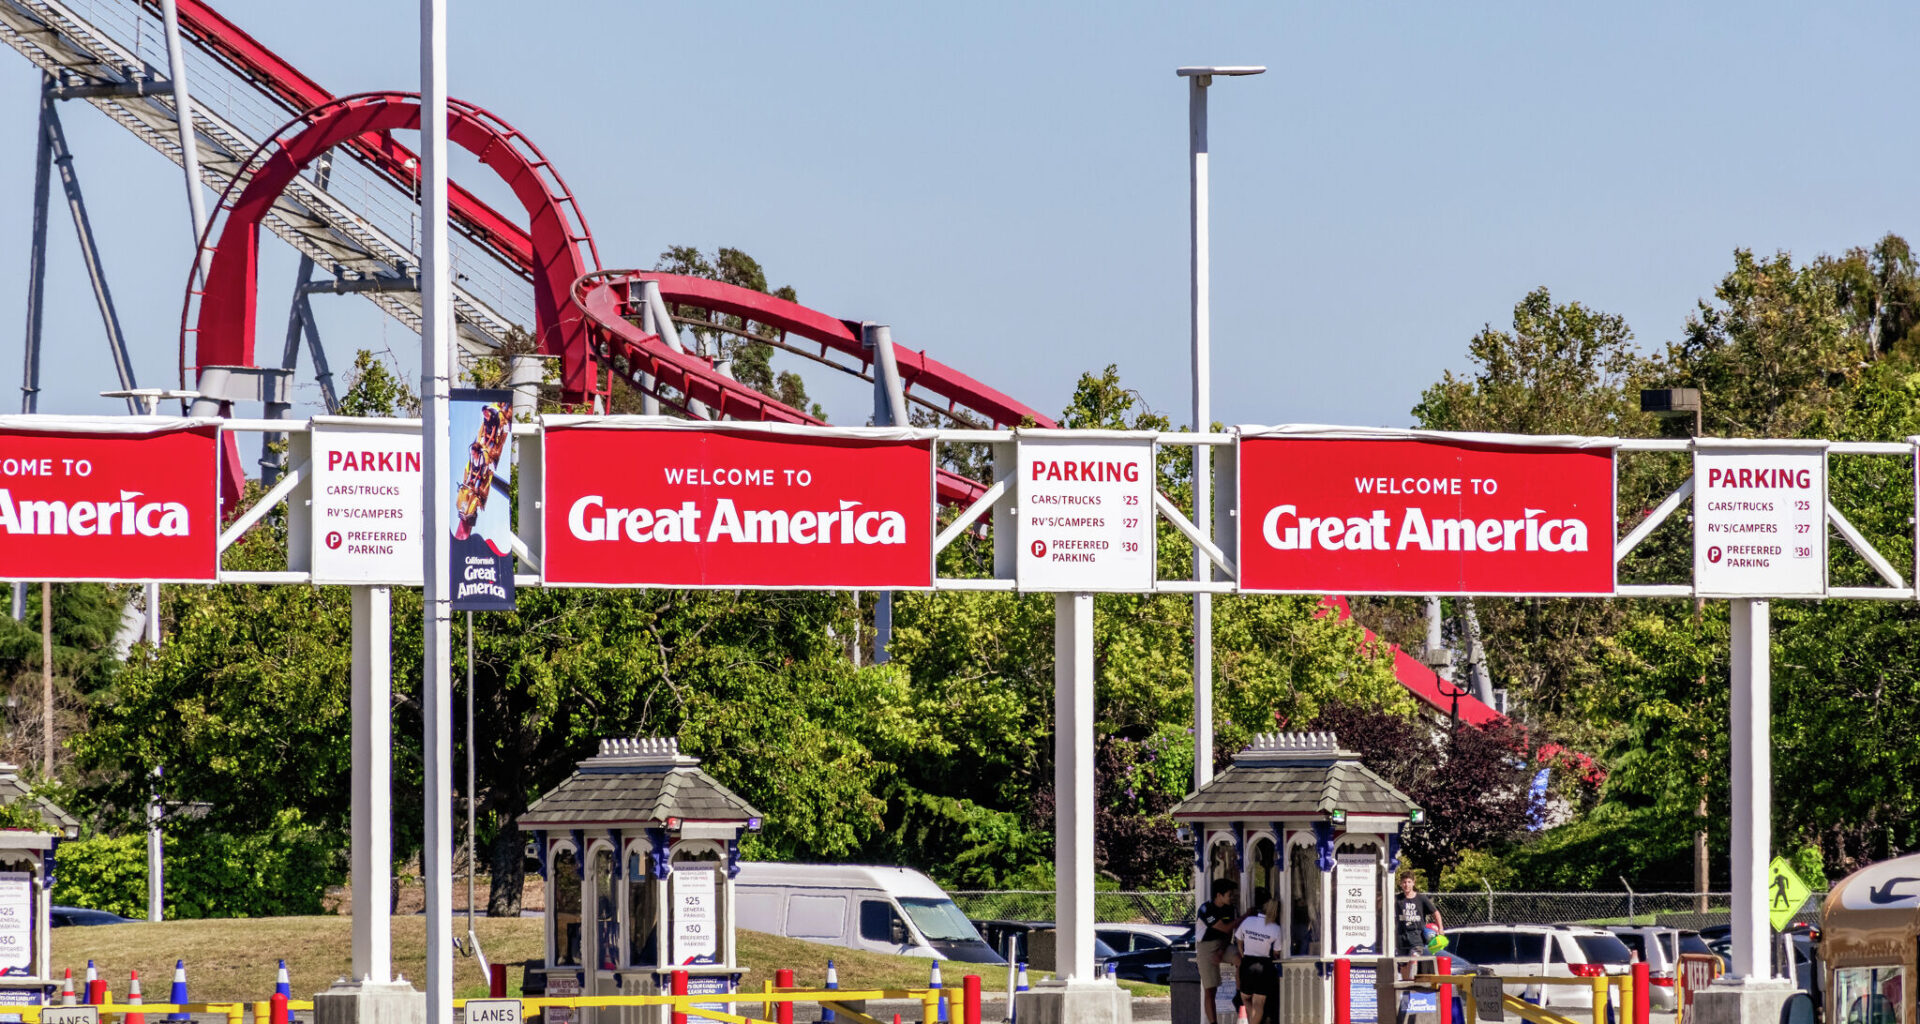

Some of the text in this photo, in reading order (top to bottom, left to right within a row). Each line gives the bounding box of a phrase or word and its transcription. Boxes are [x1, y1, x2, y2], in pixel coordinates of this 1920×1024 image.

[328, 450, 421, 473] PARKIN
[0, 458, 92, 477] OME TO
[1032, 460, 1139, 482] PARKING
[664, 467, 812, 487] WELCOME TO
[1708, 468, 1811, 489] PARKING
[326, 485, 400, 496] CARS/TRUCKS
[1354, 477, 1498, 495] WELCOME TO
[1031, 494, 1139, 506] CARS/TRUCKS $25
[1707, 501, 1810, 511] CARS/TRUCKS $25
[327, 508, 404, 519] RV'S/CAMPERS
[568, 495, 906, 545] Great America
[1031, 517, 1139, 528] RV'S/CAMPERS $27
[1262, 505, 1588, 553] Great America
[1707, 523, 1810, 534] RV'S/CAMPERS $27
[328, 533, 341, 549] P
[347, 531, 407, 541] PREFERRED
[348, 544, 394, 555] PARKING
[1033, 541, 1045, 557] P
[1052, 539, 1109, 550] PREFERRED
[1122, 542, 1139, 552] $30
[1727, 545, 1782, 555] PREFERRED
[1709, 546, 1721, 563] P
[1794, 547, 1810, 557] $30
[1052, 553, 1096, 563] PARKING
[1727, 558, 1770, 568] PARKING
[464, 565, 497, 582] Great
[457, 582, 506, 599] America
[1348, 888, 1362, 897] $25
[685, 896, 700, 905] $25
[1348, 915, 1362, 924] $30
[686, 924, 701, 933] $30
[1687, 960, 1709, 991] KEEP
[49, 1016, 90, 1024] LANES
[472, 1009, 514, 1022] LANES
